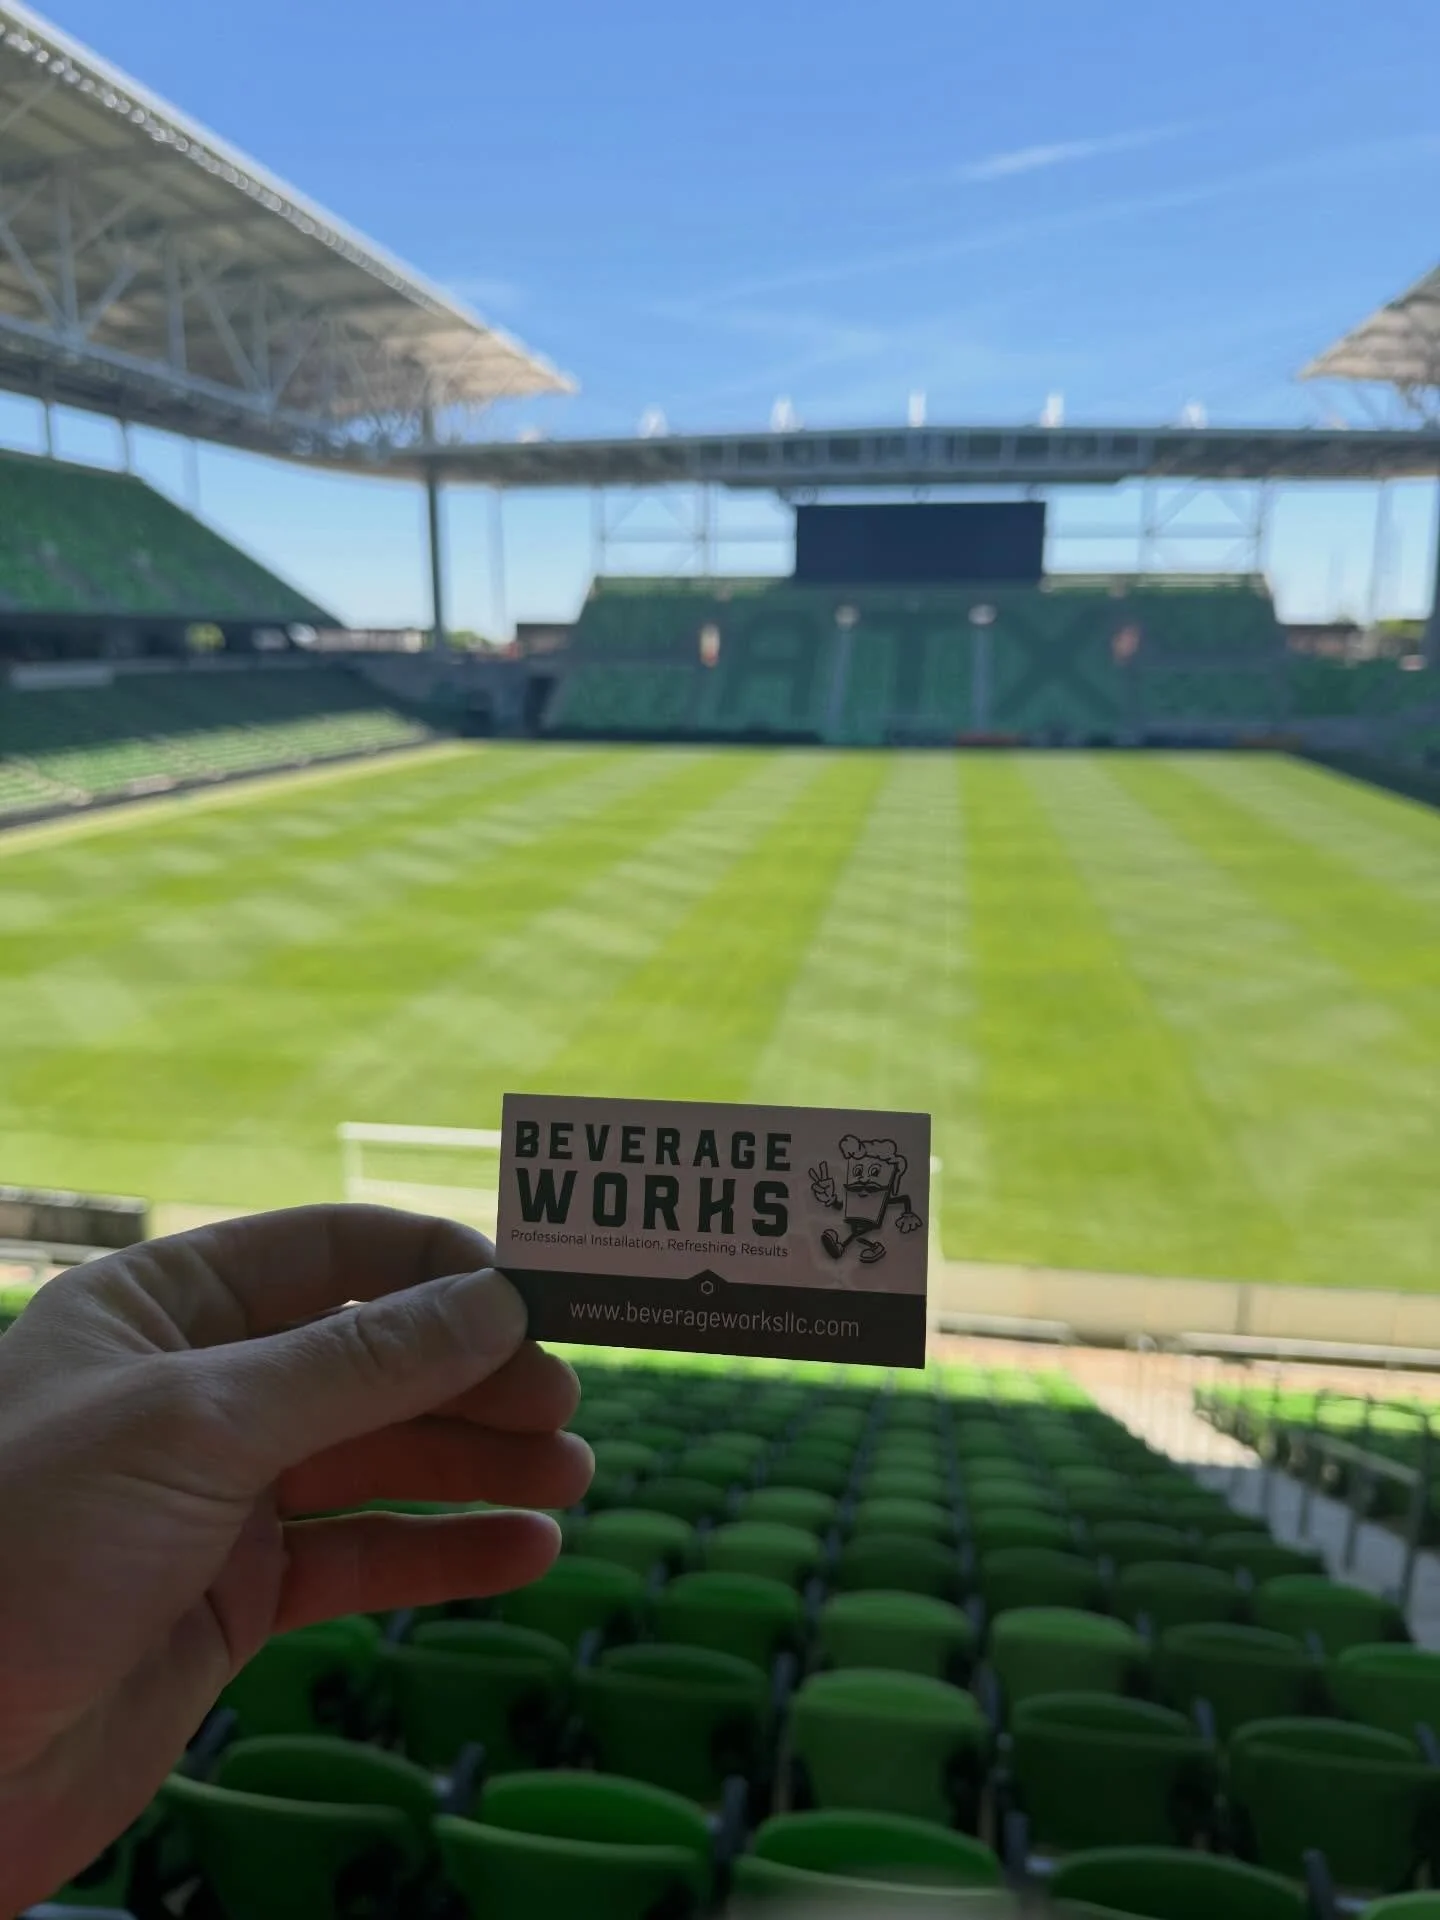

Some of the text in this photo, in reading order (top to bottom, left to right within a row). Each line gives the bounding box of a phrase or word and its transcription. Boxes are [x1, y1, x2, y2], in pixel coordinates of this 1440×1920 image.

[514, 1120, 792, 1171] BEVERAGE
[515, 1167, 789, 1237] WORKS
[510, 1229, 789, 1258] Professional Installation, Refreshing Results
[569, 1301, 860, 1337] www.beverageworksllc.com
